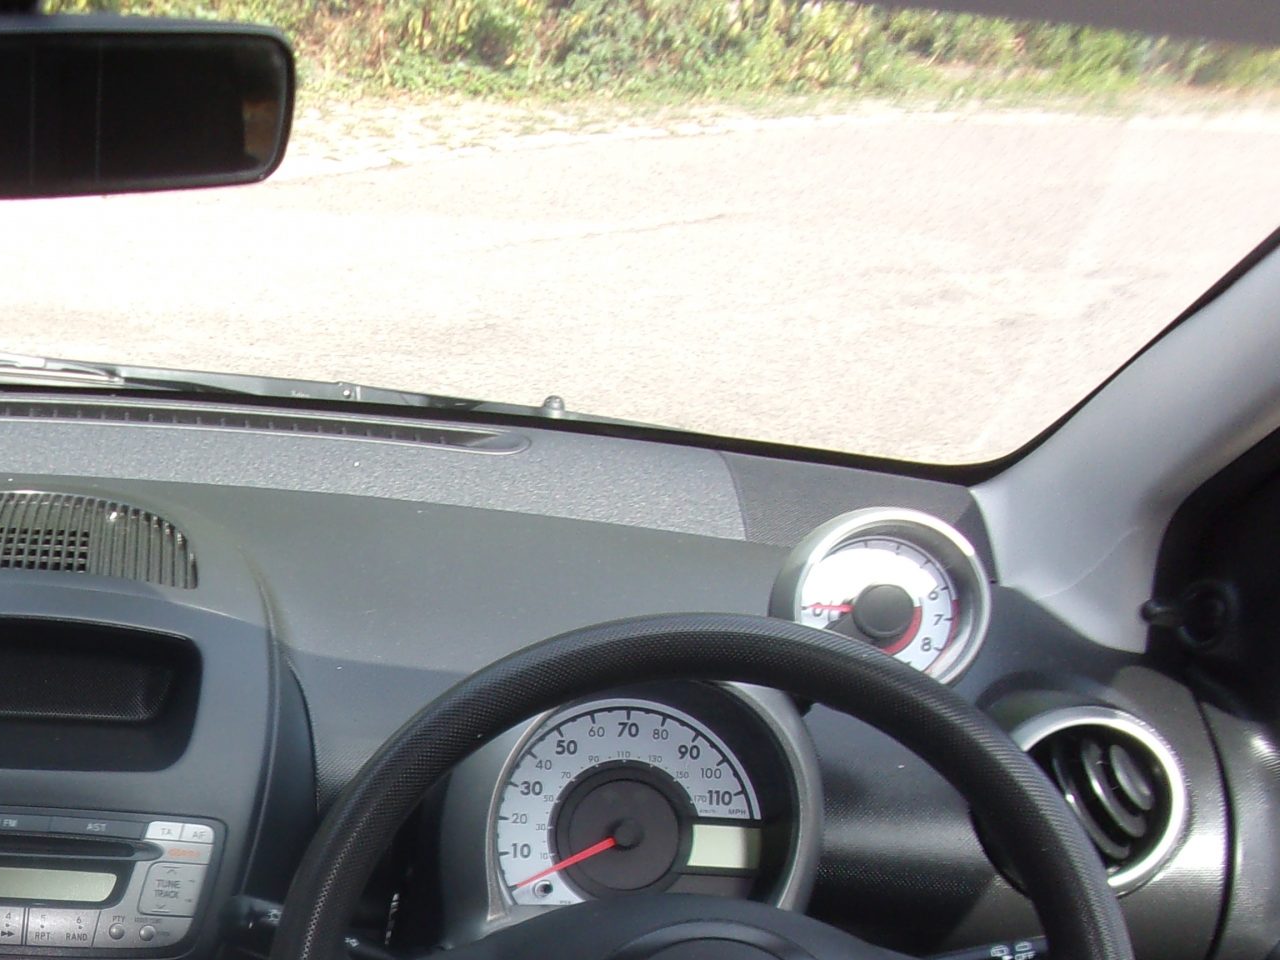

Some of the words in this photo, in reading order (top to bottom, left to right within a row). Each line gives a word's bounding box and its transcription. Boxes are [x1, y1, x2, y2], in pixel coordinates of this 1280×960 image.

[929, 585, 939, 600] 6
[933, 614, 944, 626] 7
[921, 638, 932, 651] 8
[588, 726, 605, 738] 60
[617, 721, 639, 738] 70
[652, 728, 669, 740] 80
[555, 740, 578, 755] 50
[678, 744, 701, 760] 90
[535, 759, 552, 771] 40
[588, 755, 600, 763] 90
[648, 755, 662, 763] 130
[560, 771, 571, 779] 70
[676, 771, 689, 779] 150
[700, 768, 722, 779] 100
[520, 780, 543, 796] 30
[707, 790, 733, 806] 110
[511, 813, 528, 825] 20
[535, 823, 546, 831] 30
[511, 843, 531, 859] 10
[156, 879, 181, 889] TUNE
[154, 889, 179, 899] TRACK
[4, 912, 11, 920] 4
[76, 916, 82, 924] 6
[35, 931, 51, 940] RPT
[65, 932, 88, 941] RAND
